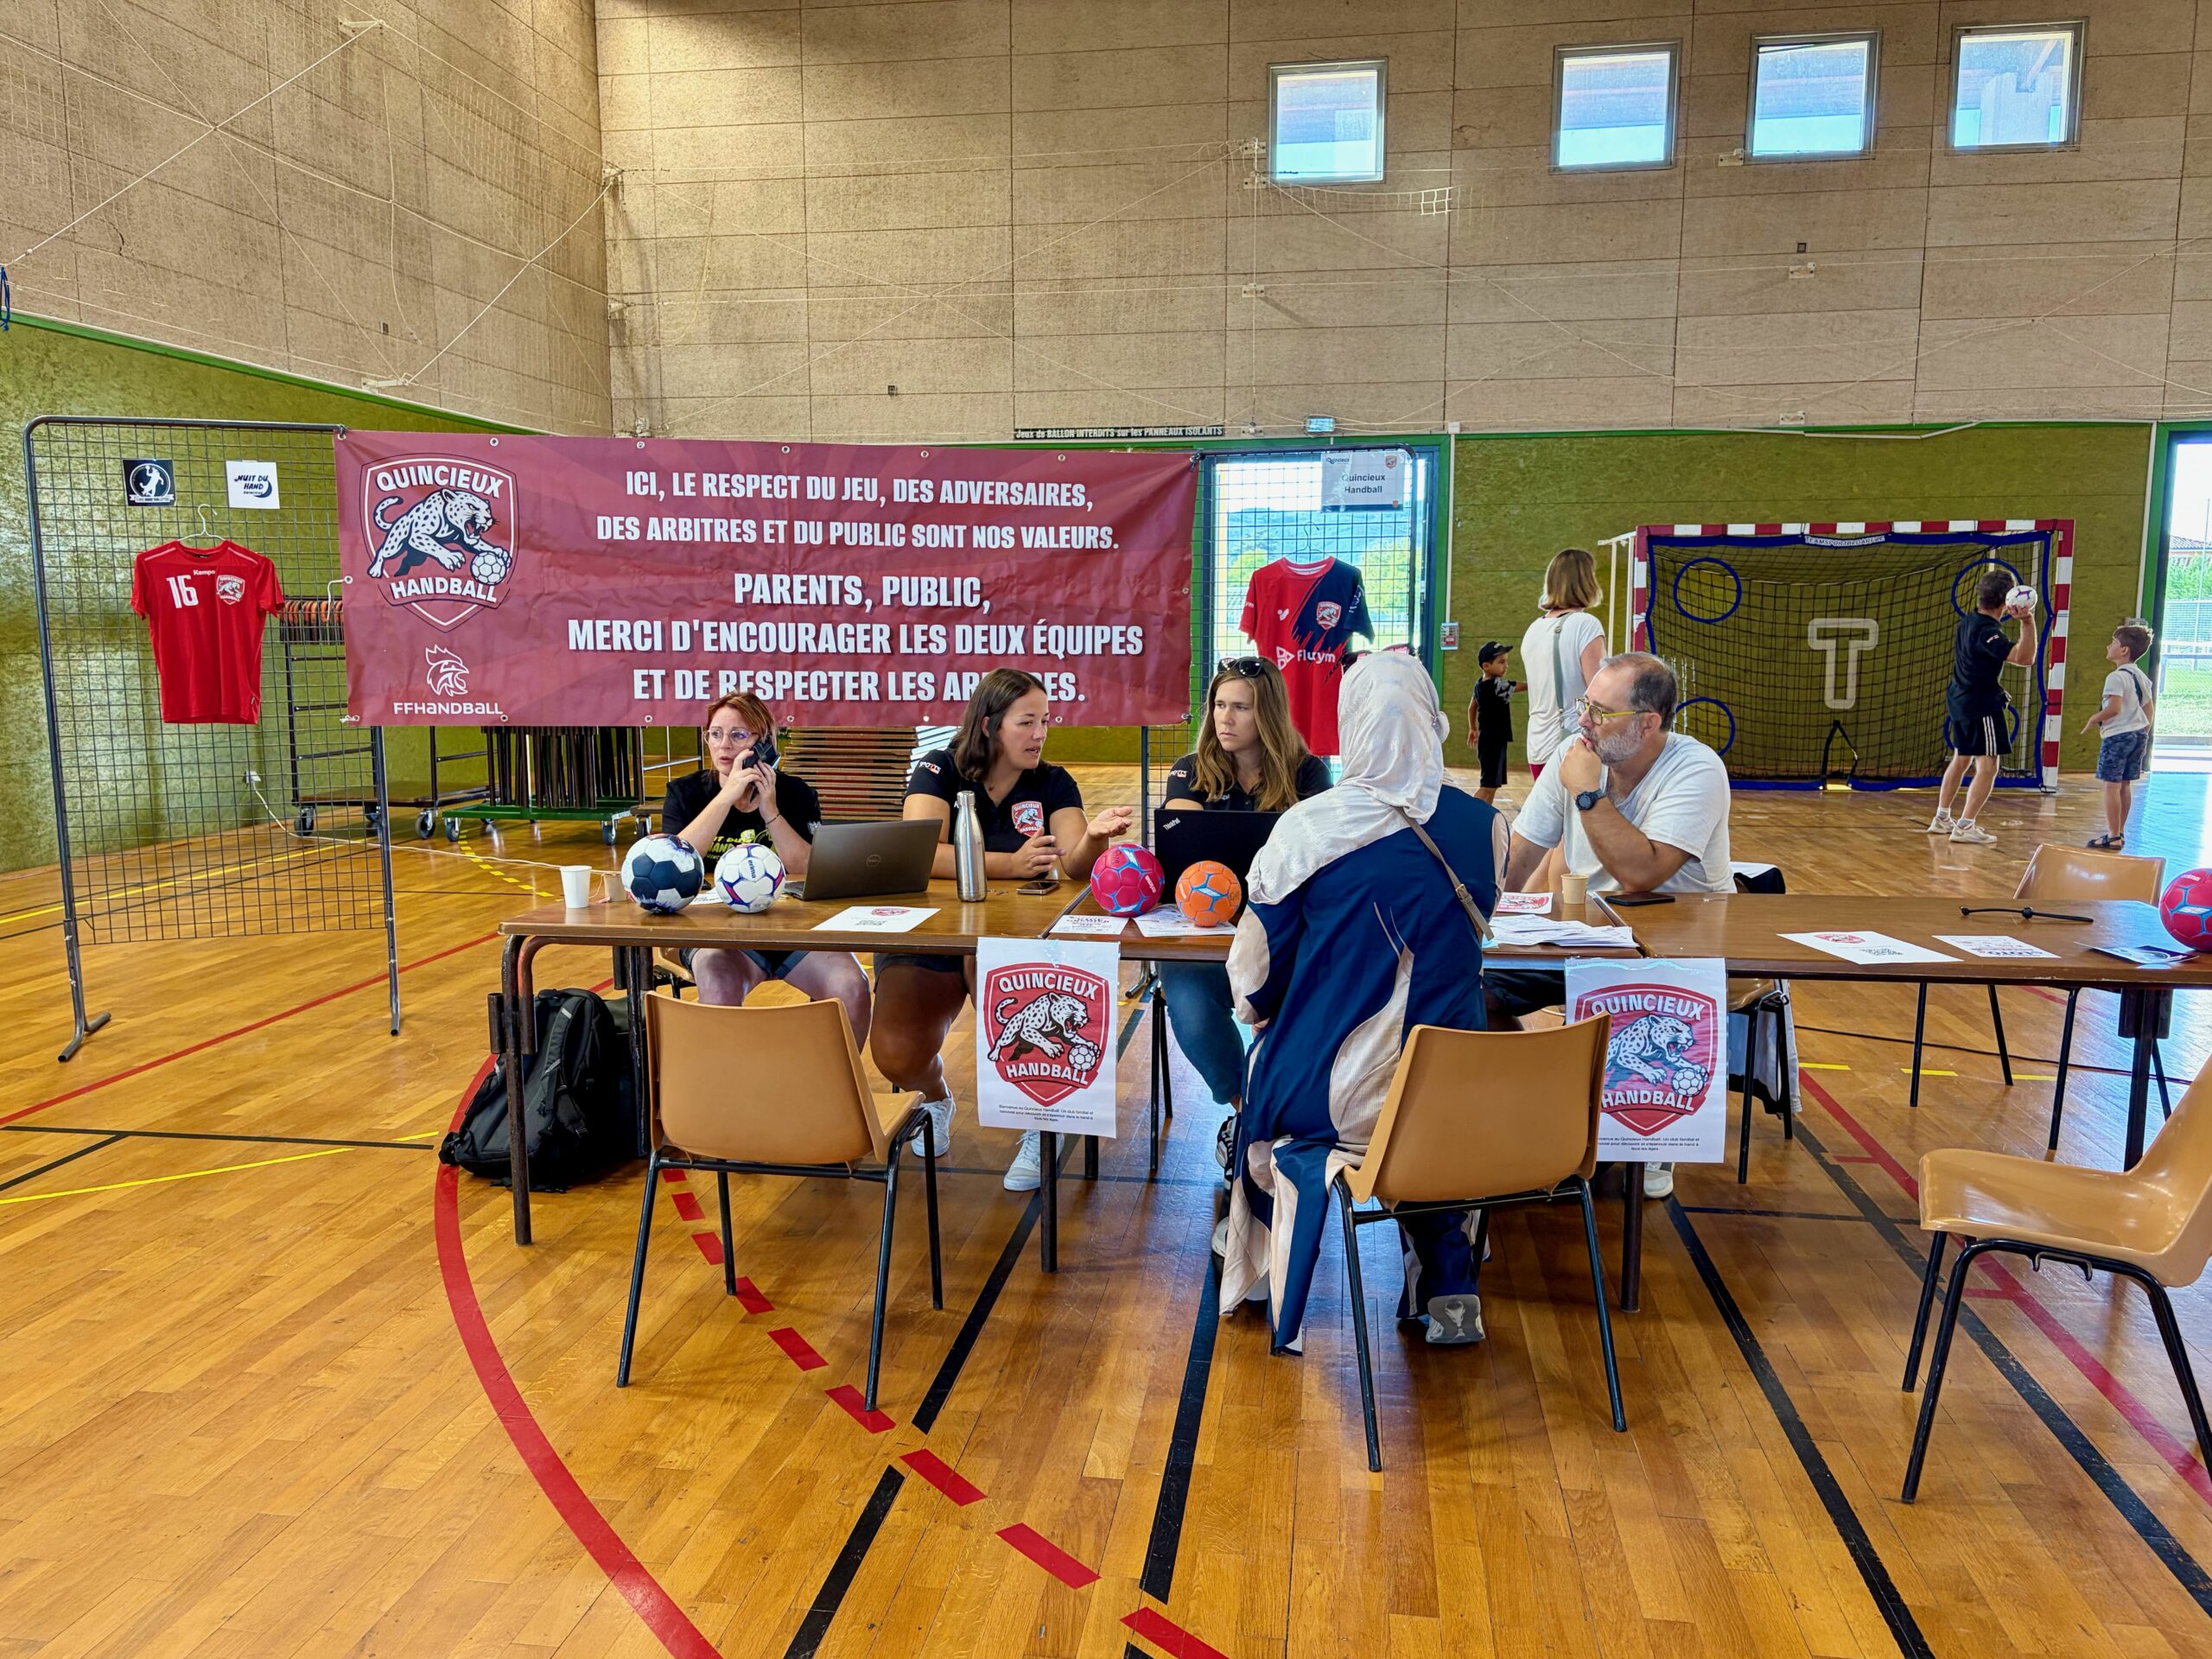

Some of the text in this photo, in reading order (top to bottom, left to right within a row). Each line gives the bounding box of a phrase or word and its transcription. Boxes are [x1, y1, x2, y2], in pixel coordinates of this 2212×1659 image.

[1036, 429, 1046, 438] de
[377, 465, 504, 499] QUINCIEUX
[626, 471, 1094, 512] ICI, LE RESPECT DU JEU, DES ADVERSAIRES,
[597, 515, 1119, 550] DES ARBITRES ET DU PUBLIC SONT NOS VALEURS.
[166, 575, 199, 609] 16
[390, 576, 498, 603] HANDBALL
[734, 573, 991, 614] PARENTS, PUBLIC,
[568, 619, 1144, 660] MERCI D'ENCOURAGER LES DEUX ÉQUIPES
[633, 669, 1086, 702] ET DE RESPECTER LES ARES.
[1162, 817, 1181, 831] ThinkPad
[747, 859, 756, 880] erima
[1144, 874, 1157, 893] erima
[999, 972, 1099, 1001] QUINCIEUX
[1591, 994, 1705, 1021] QUINCIEUX
[1005, 1062, 1089, 1085] HANDBALL
[1601, 1090, 1694, 1112] HANDBALL
